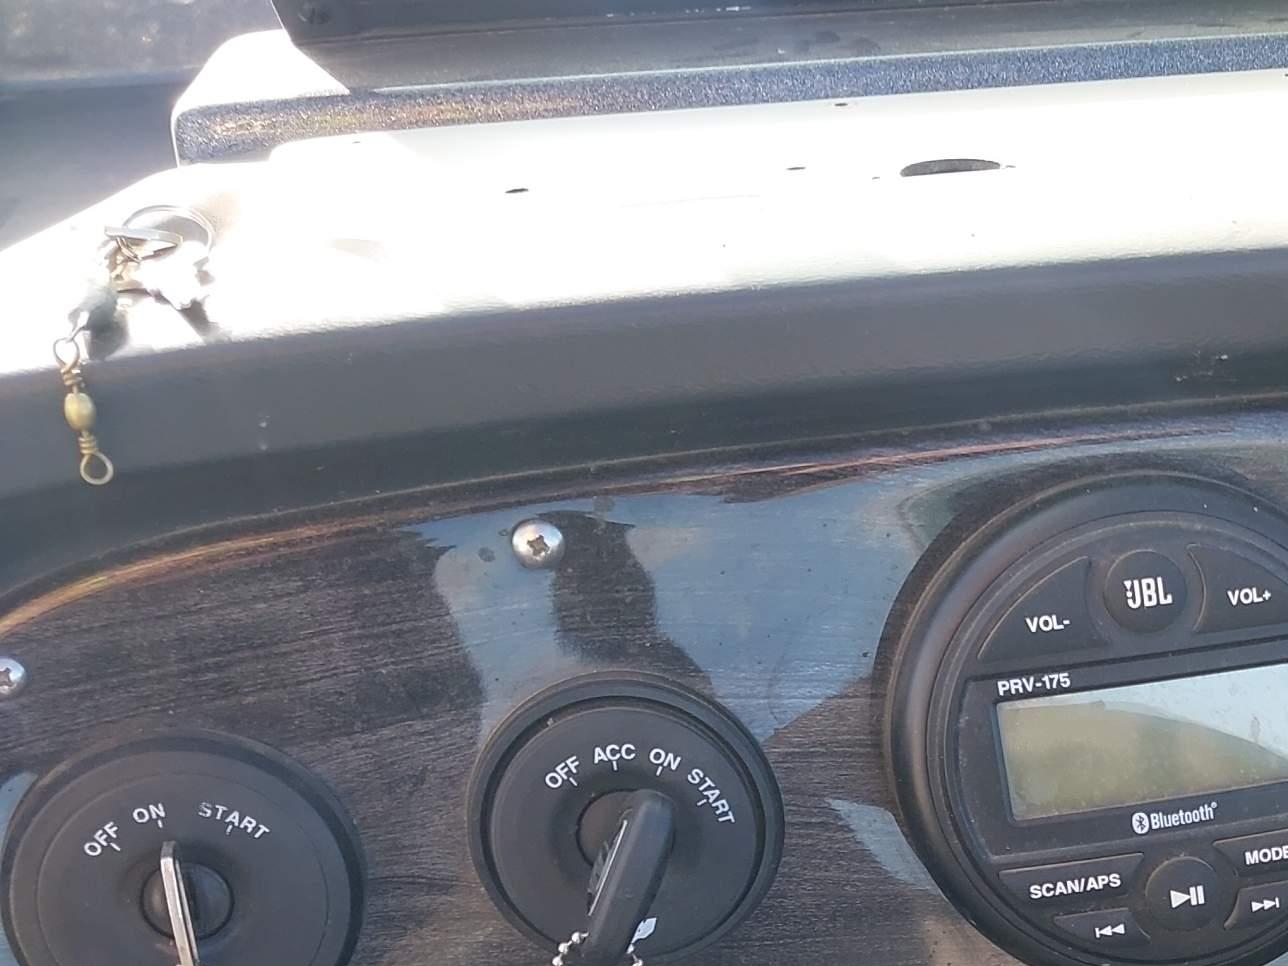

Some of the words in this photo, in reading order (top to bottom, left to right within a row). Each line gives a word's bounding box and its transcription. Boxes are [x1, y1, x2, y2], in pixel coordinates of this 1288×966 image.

[1124, 577, 1172, 609] JBL
[1227, 587, 1272, 605] VOL+
[1026, 615, 1070, 632] VOL-
[997, 673, 1071, 697] PRV-175
[546, 756, 580, 789] OFF
[594, 744, 636, 764] ACC
[649, 747, 681, 772] ON
[687, 768, 735, 824] START
[84, 822, 120, 857] OFF
[132, 803, 166, 826] ON
[198, 802, 269, 839] START
[1029, 872, 1121, 899] SCAN/APS
